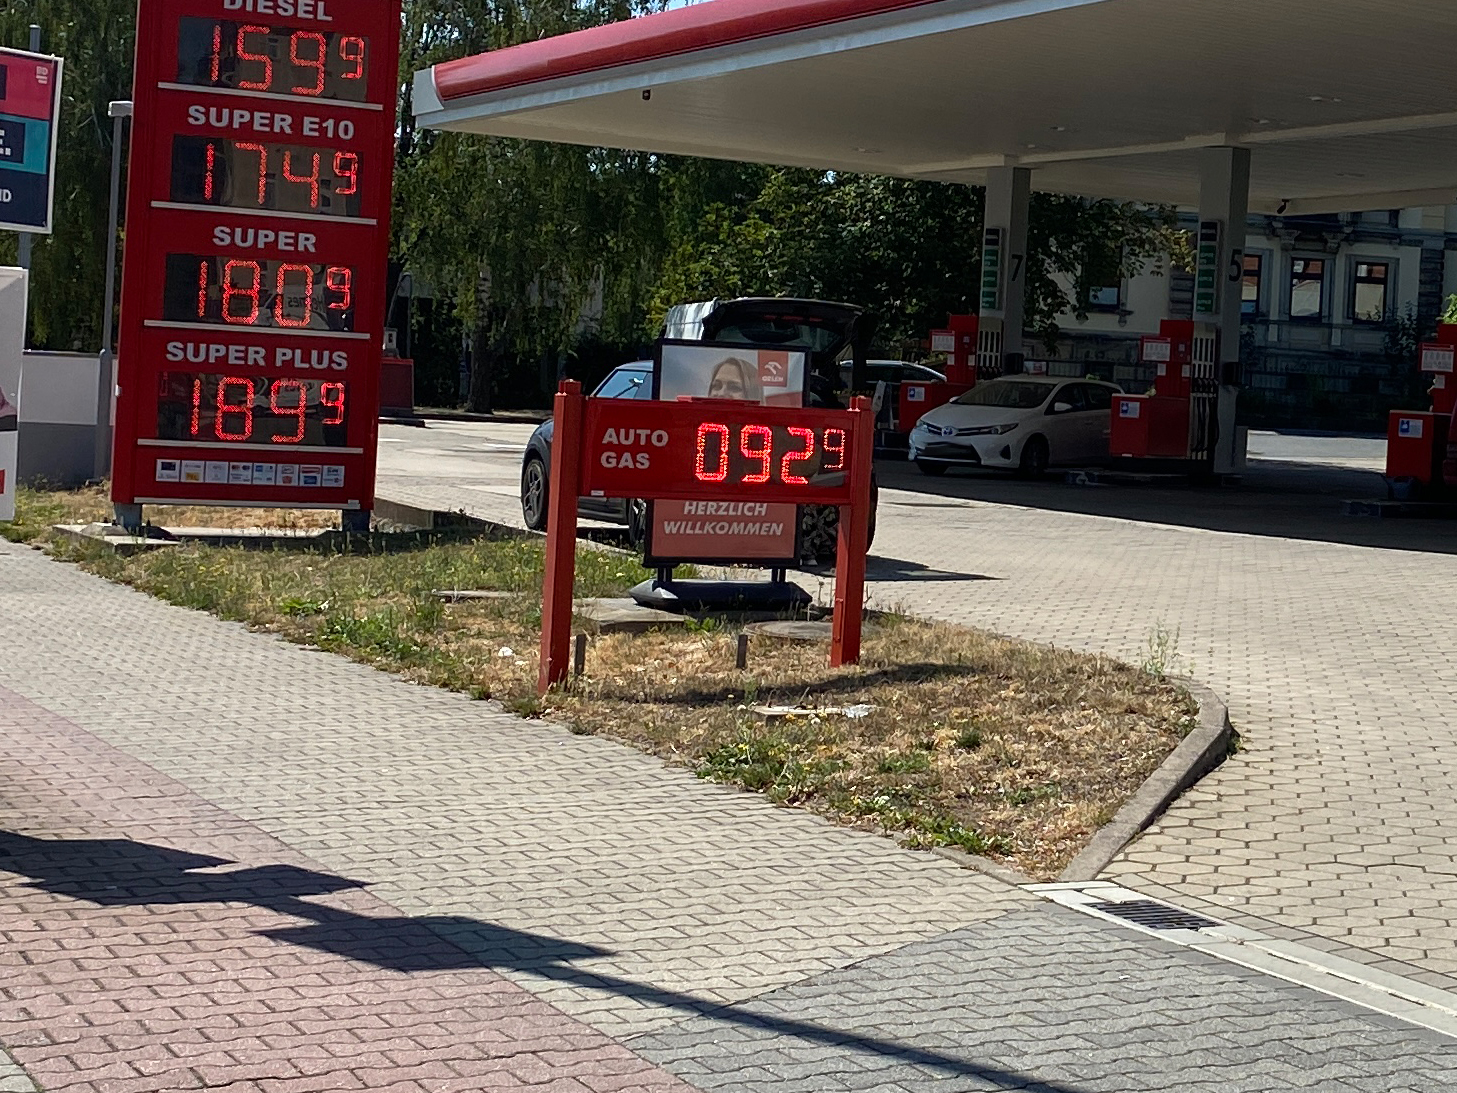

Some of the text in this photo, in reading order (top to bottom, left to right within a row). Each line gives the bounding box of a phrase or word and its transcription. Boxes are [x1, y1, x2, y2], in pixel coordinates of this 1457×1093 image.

[187, 105, 355, 140] SUPER E10
[213, 226, 316, 252] SUPER
[1011, 254, 1023, 281] 7
[1228, 248, 1242, 282] 5
[166, 341, 348, 370] SUPER PLUS
[601, 427, 669, 447] AUTO
[600, 451, 651, 470] GAS
[683, 501, 768, 517] HERZLICH
[663, 520, 784, 537] WILLKOMMEN
